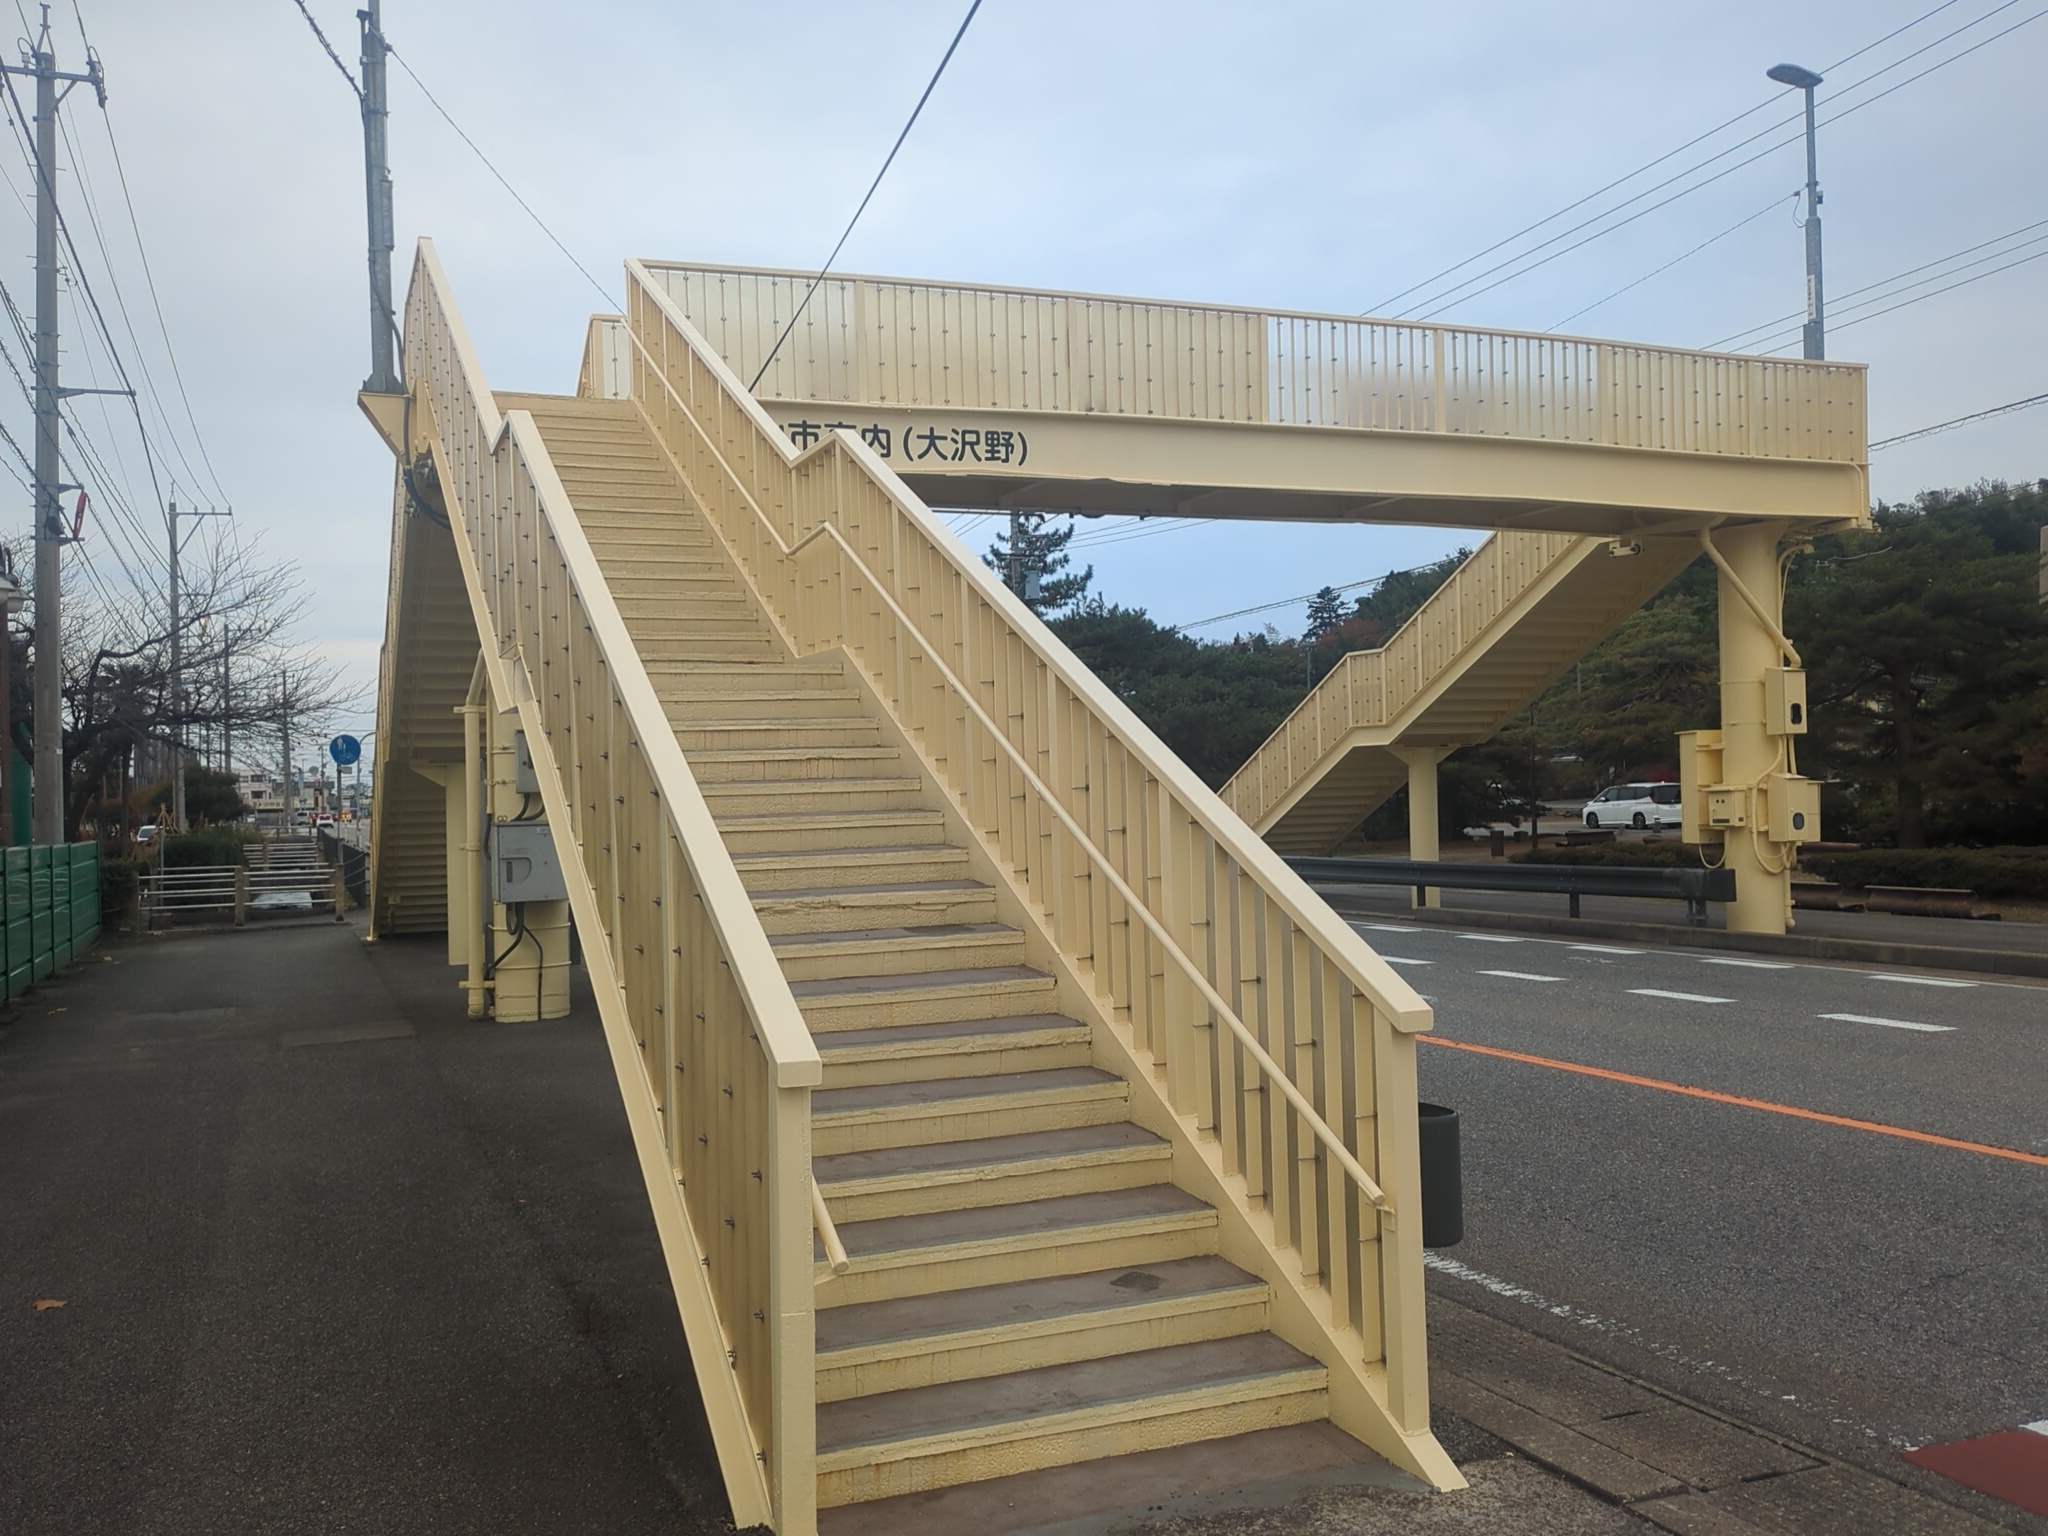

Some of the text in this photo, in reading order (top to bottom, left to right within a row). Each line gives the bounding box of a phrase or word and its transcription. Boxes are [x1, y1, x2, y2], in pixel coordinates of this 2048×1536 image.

[779, 420, 1028, 466] 市内(大沢野)
